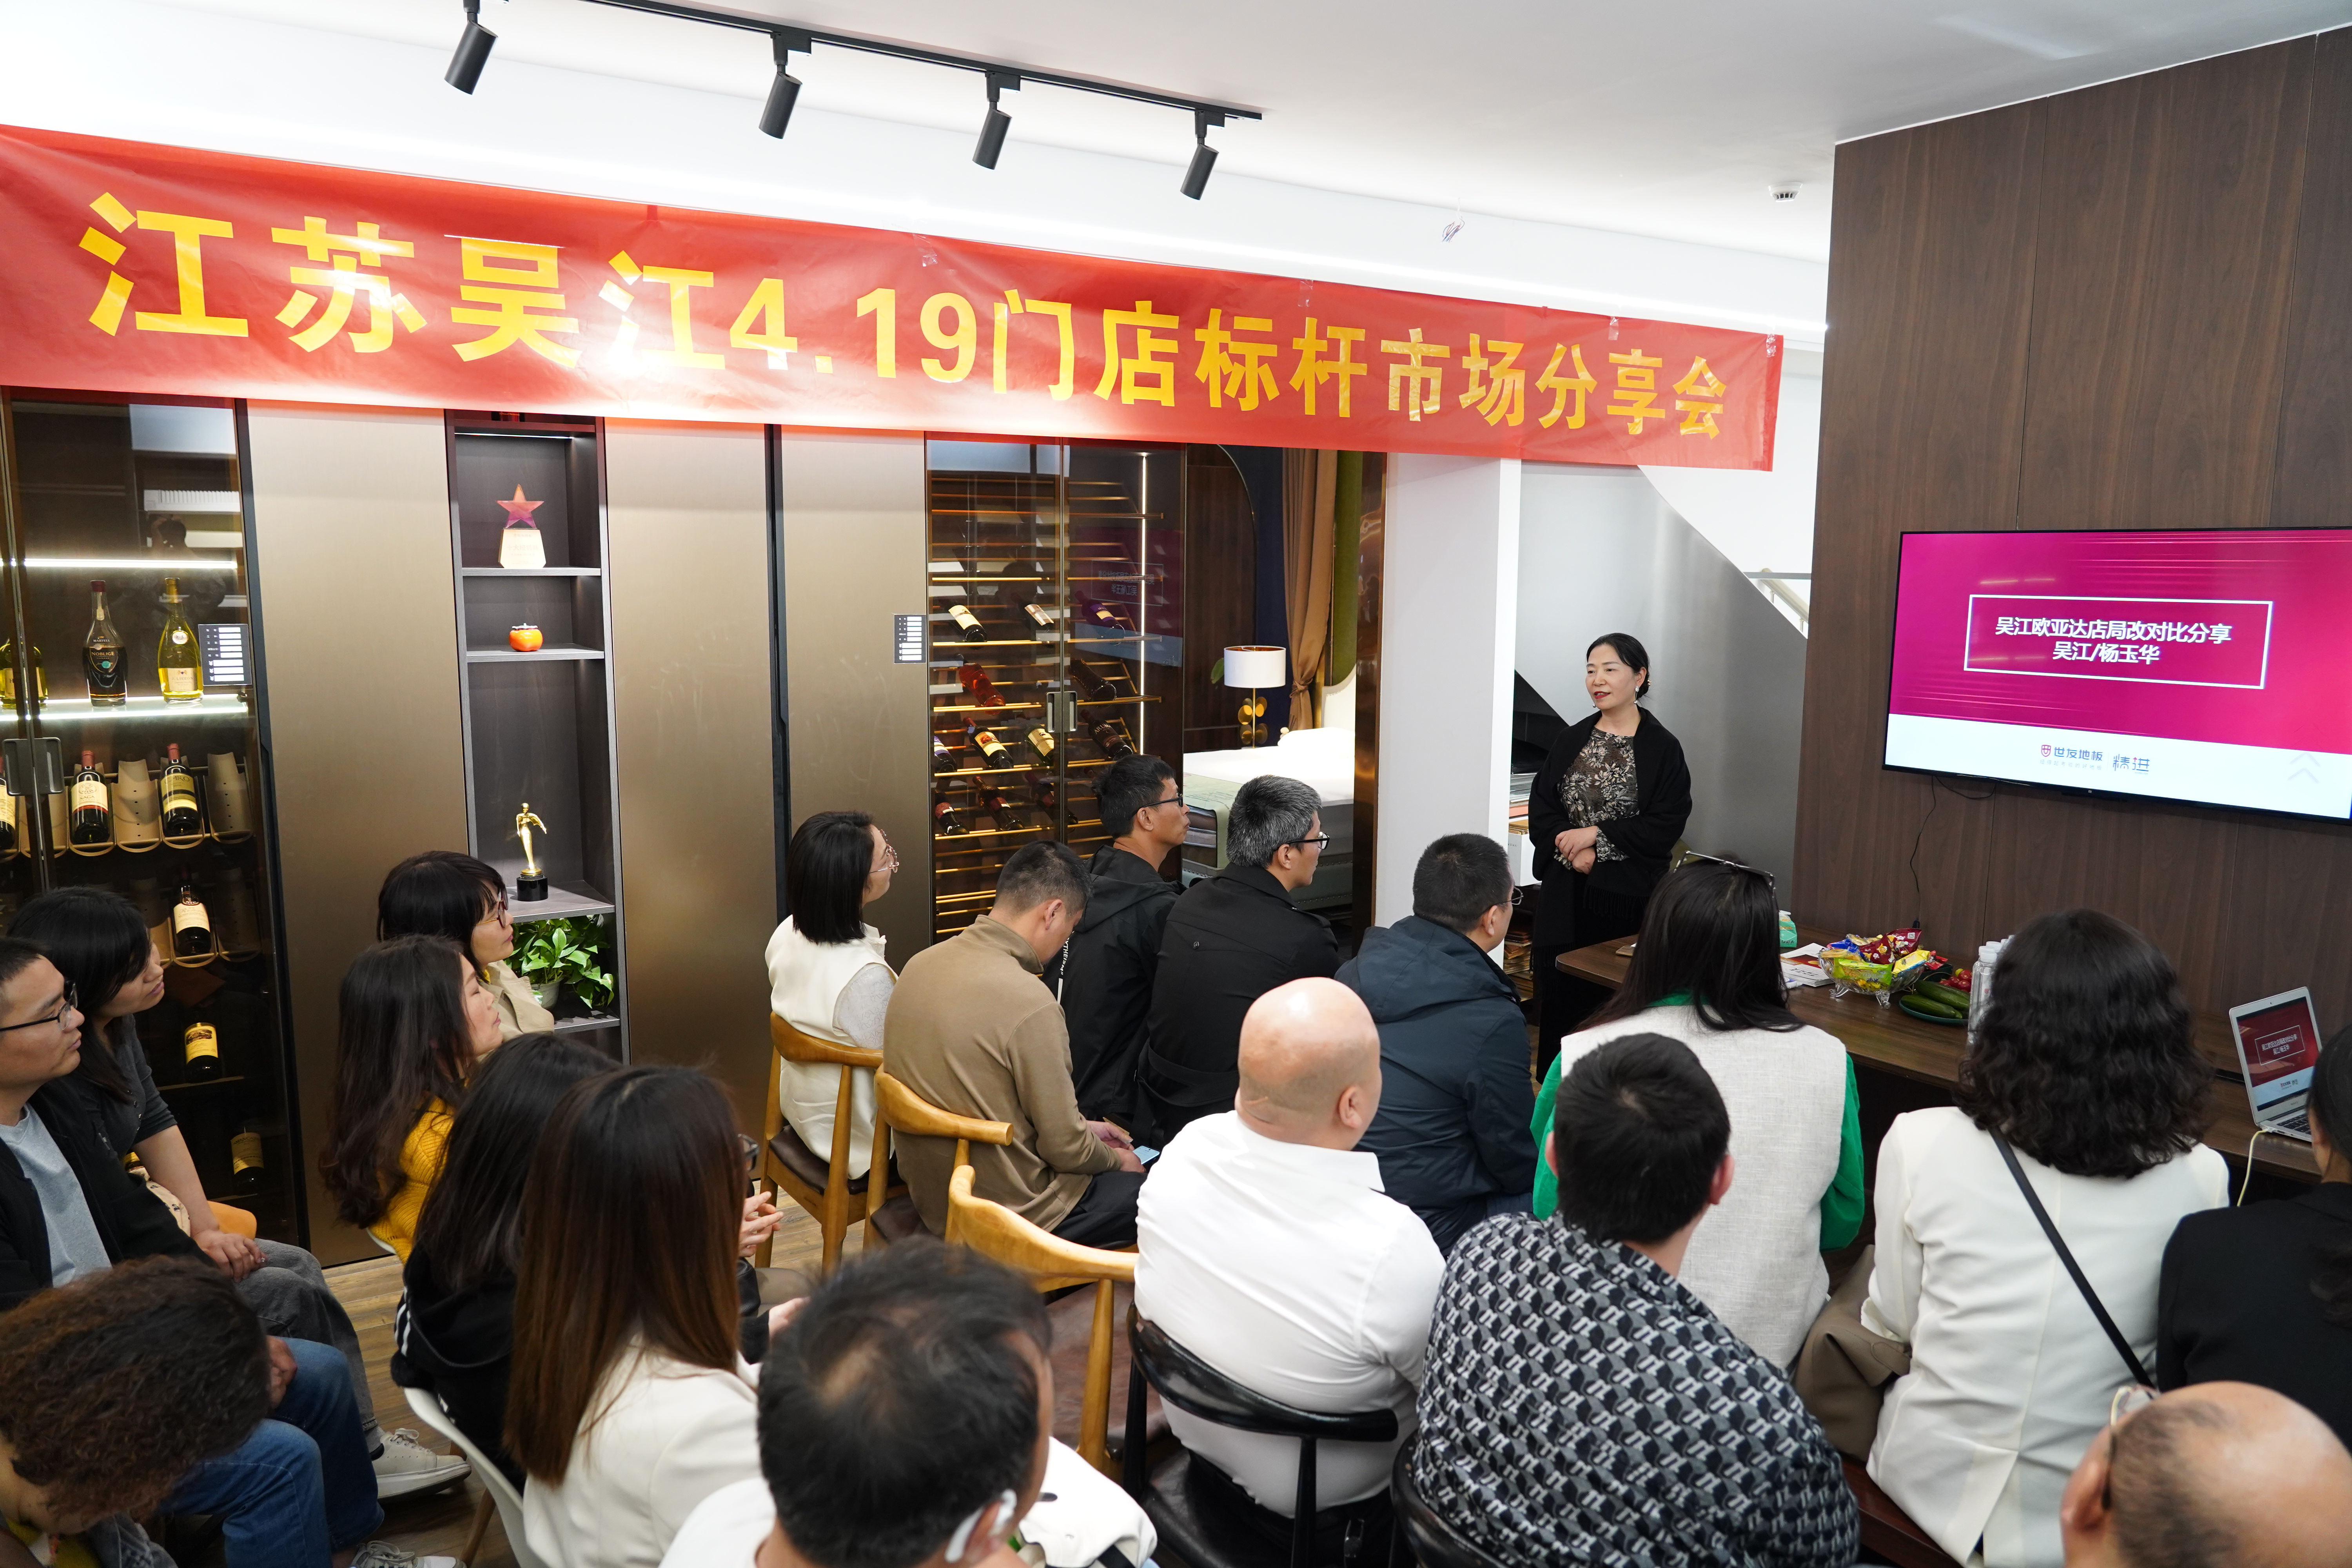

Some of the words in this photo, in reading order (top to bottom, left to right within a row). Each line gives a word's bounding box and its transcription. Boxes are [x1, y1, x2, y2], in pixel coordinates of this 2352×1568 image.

[78, 191, 1727, 439] 江苏吴江4.19门店标杆市场分享会
[1995, 616, 2232, 644] 吴江欧亚达店局改对比分享
[2052, 641, 2160, 665] 吴江/杨玉华
[2054, 746, 2103, 762] 世友地板
[2112, 753, 2151, 771] 精进
[2040, 759, 2102, 771] 经得起考验的好地板
